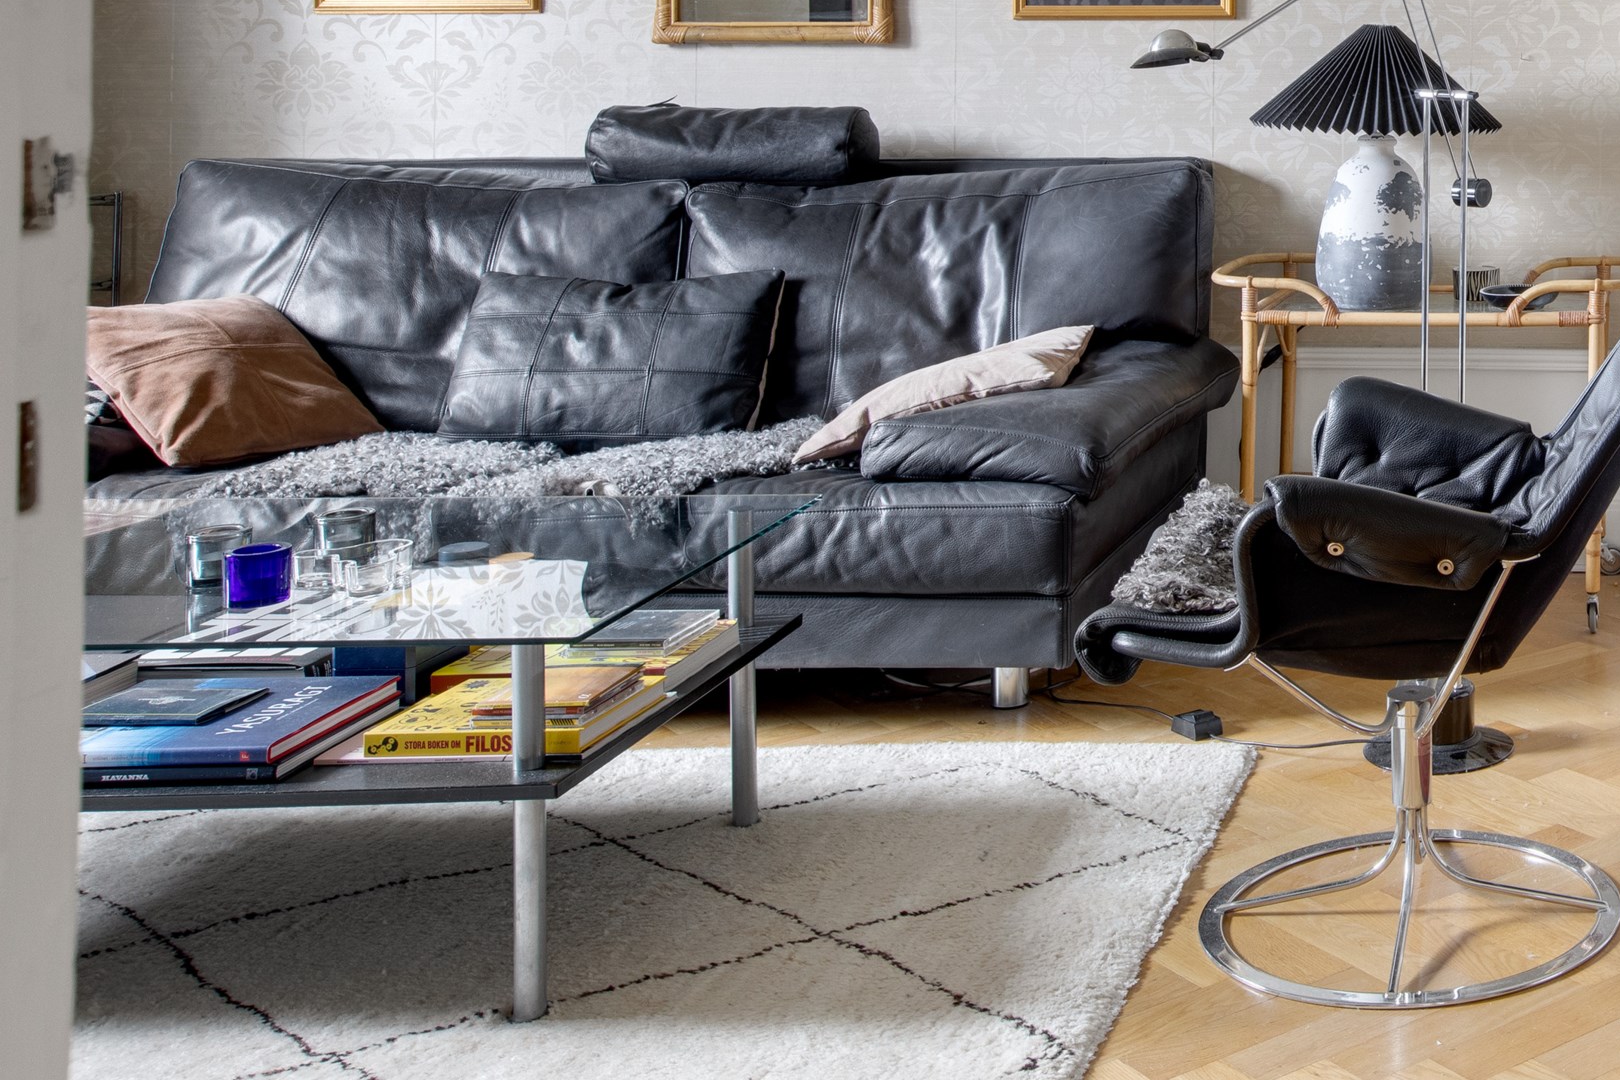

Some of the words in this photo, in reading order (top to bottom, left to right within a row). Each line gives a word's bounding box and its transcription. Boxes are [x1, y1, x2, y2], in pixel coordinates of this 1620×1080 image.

[215, 684, 334, 736] YASURAGI
[404, 740, 427, 750] STORA
[427, 740, 449, 750] BOKEN
[449, 740, 461, 749] OM
[102, 774, 151, 782] HAVANNA
